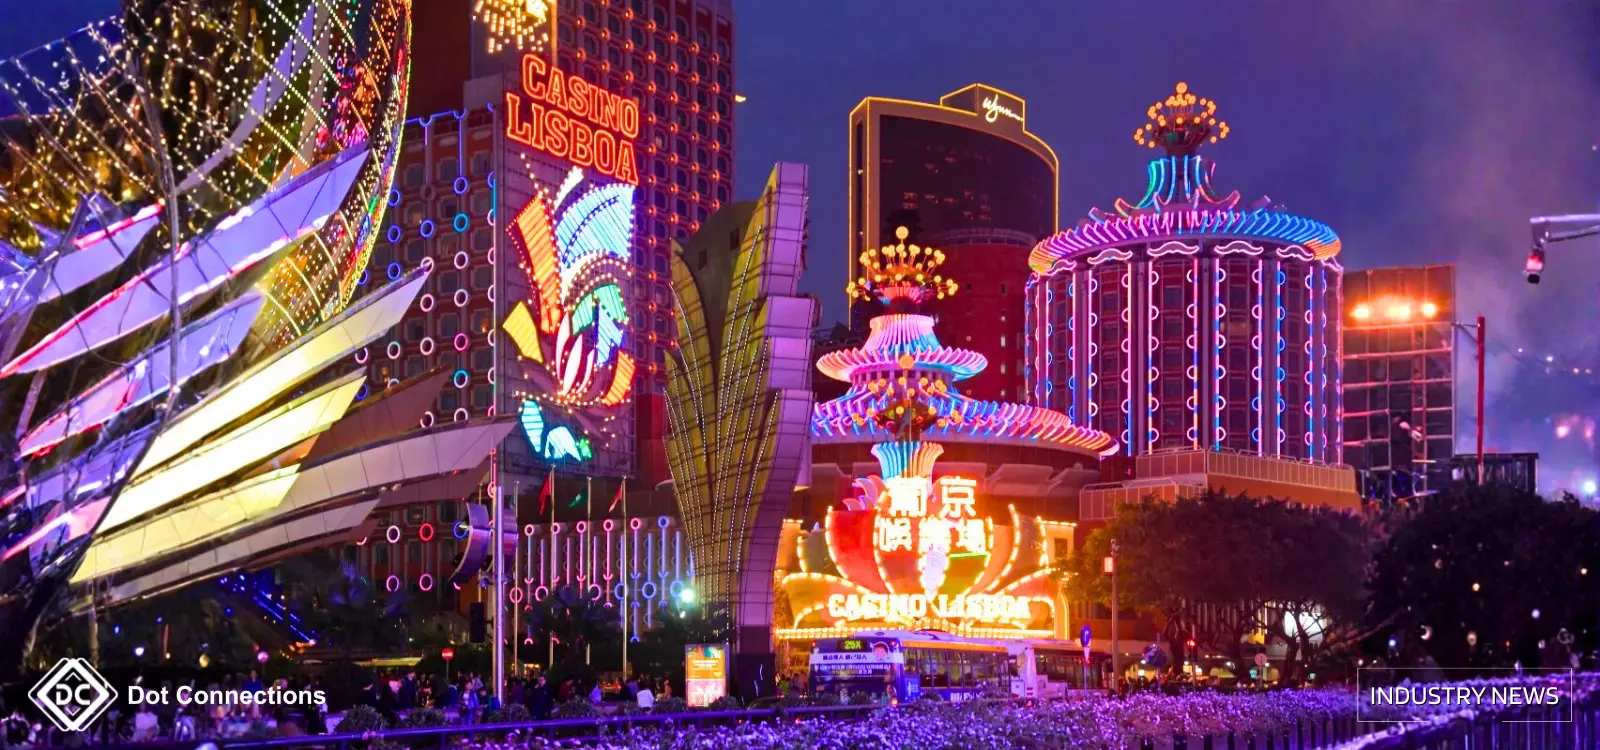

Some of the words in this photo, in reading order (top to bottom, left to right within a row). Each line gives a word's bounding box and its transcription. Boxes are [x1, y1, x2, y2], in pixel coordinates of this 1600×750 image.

[523, 54, 639, 138] CASINO
[506, 92, 638, 186] LISBOA
[828, 593, 927, 619] CASINO
[938, 593, 1031, 620] LISBOA
